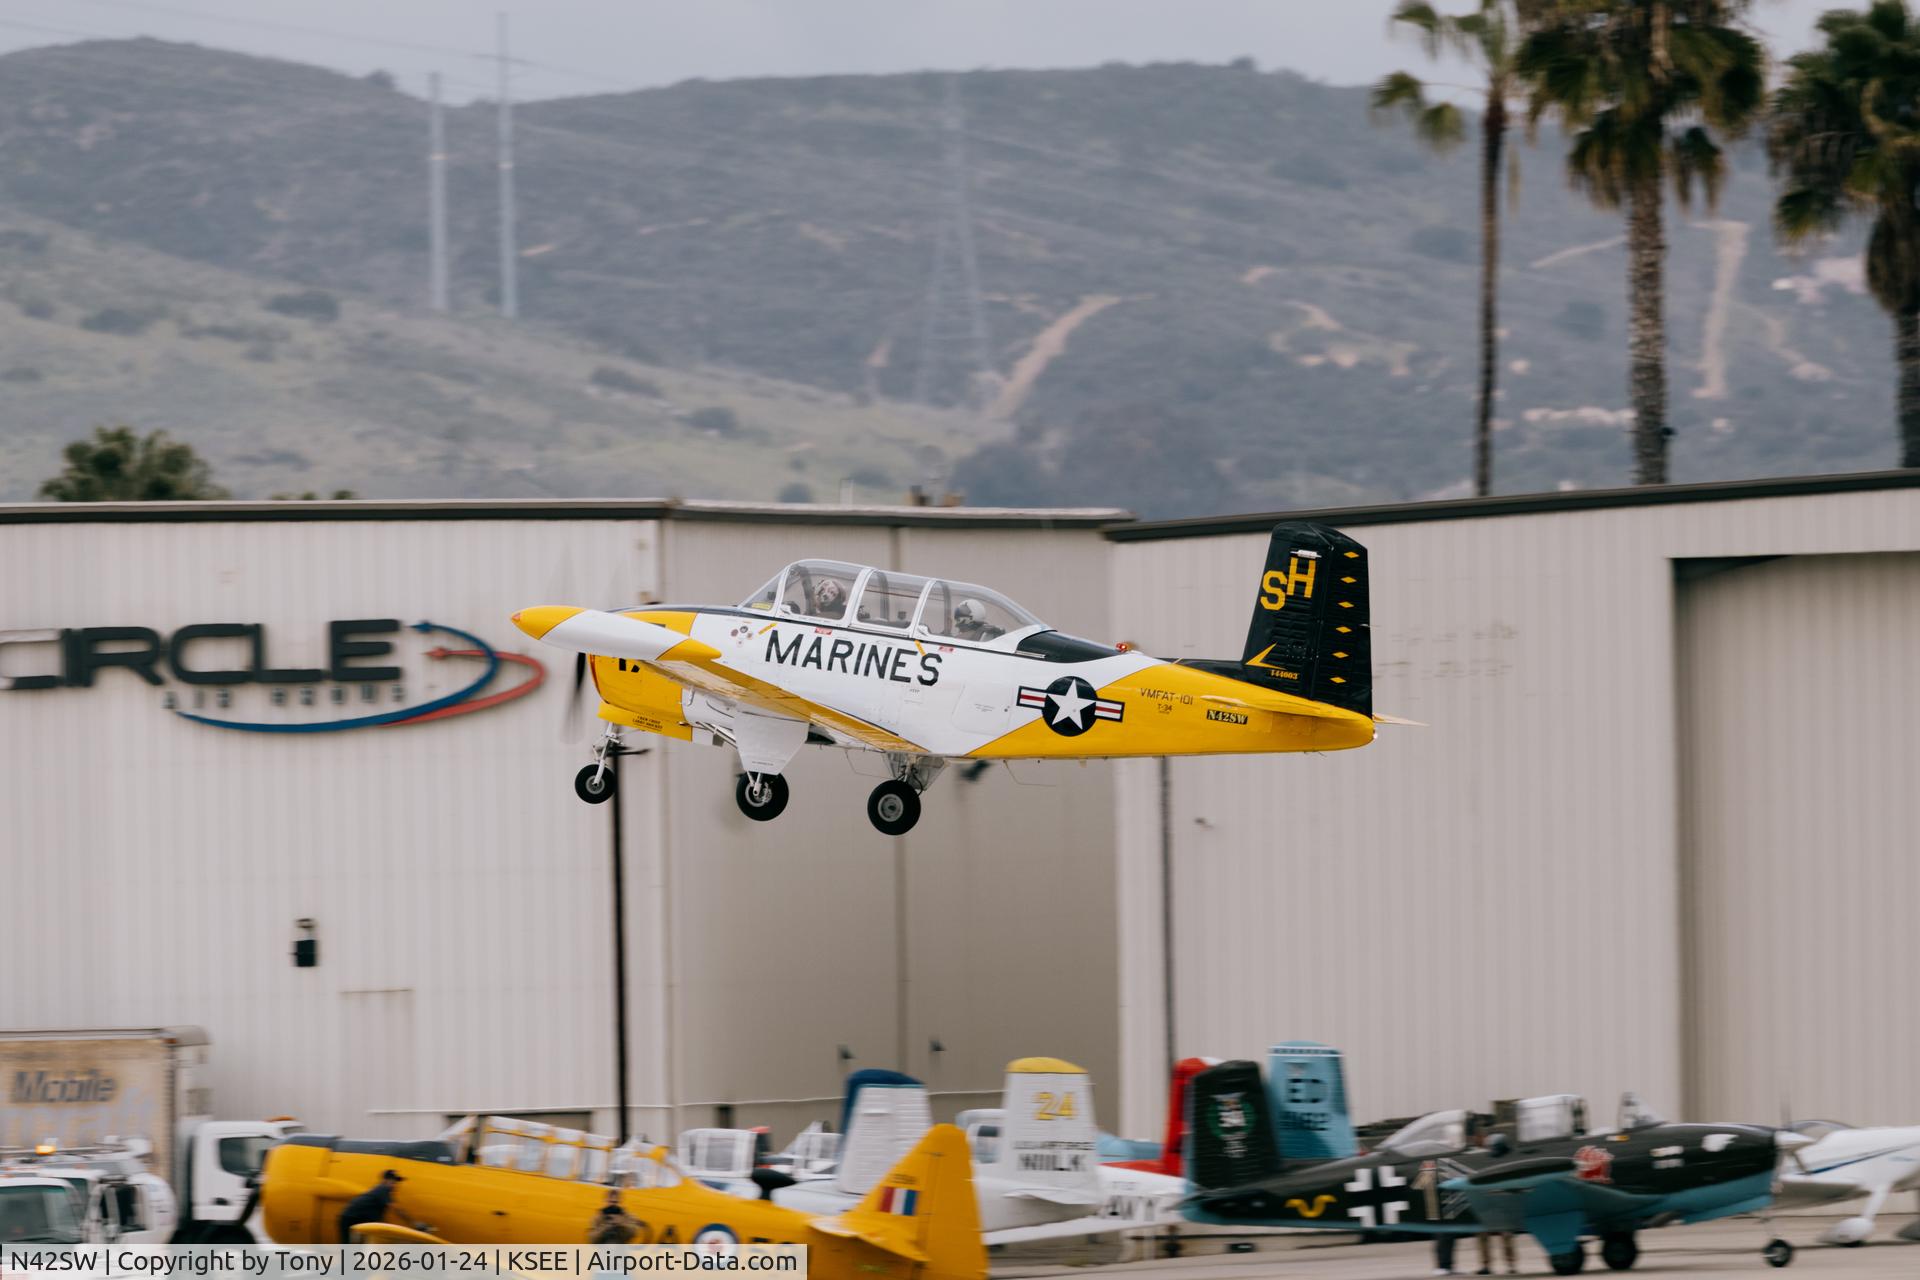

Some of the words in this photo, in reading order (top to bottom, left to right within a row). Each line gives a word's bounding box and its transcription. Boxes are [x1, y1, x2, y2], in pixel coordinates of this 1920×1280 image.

[765, 629, 943, 687] MARINES
[1140, 687, 1194, 706] VMFAT-101
[1207, 710, 1248, 725] N42SW
[1031, 1091, 1076, 1122] 24
